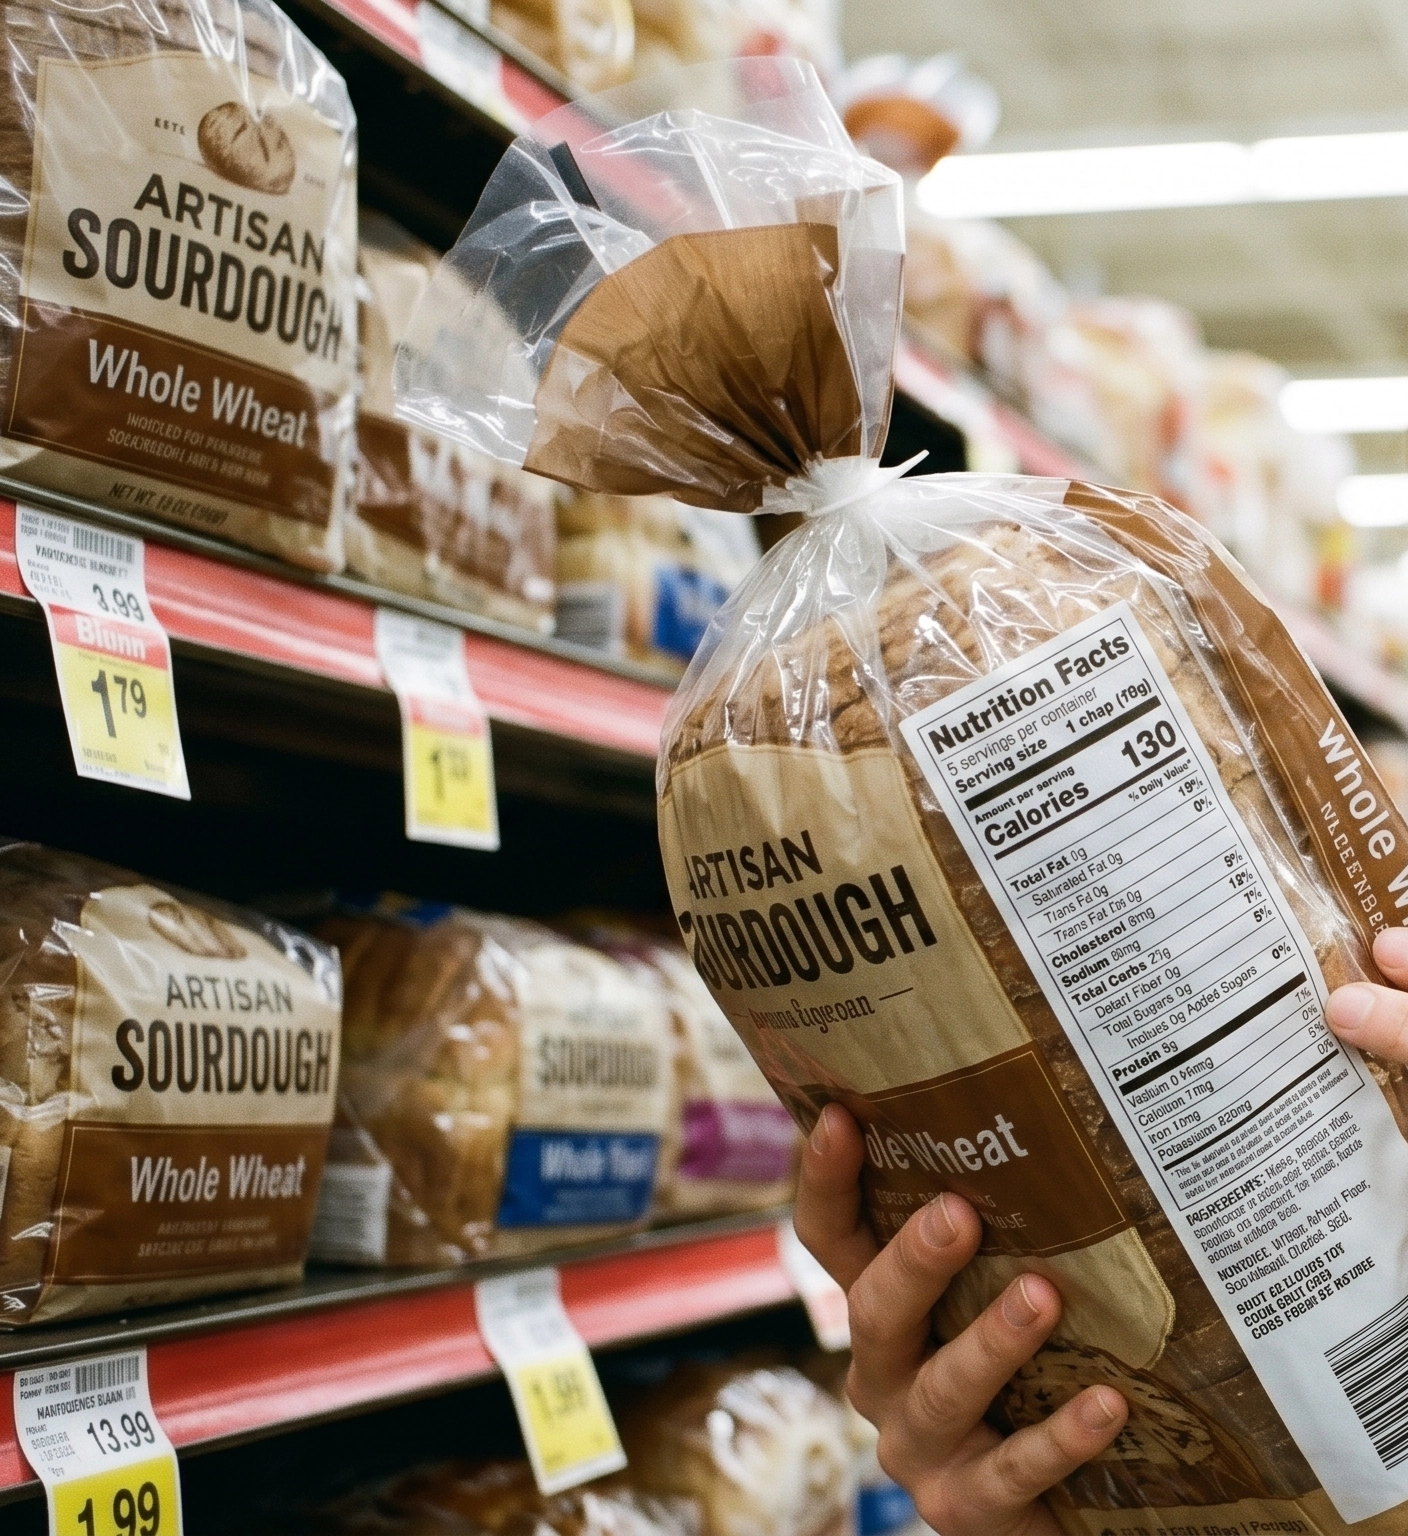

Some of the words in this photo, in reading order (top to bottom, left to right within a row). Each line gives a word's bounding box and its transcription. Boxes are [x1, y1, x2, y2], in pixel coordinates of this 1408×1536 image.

[133, 173, 325, 278] ARTISAN
[62, 207, 344, 363] SOURDOUGH
[88, 338, 202, 413] Whole
[212, 376, 310, 448] Wheat
[927, 678, 1055, 755] Nutrition
[1053, 635, 1130, 686] Facts
[946, 761, 959, 777] 5
[959, 734, 1017, 771] servings
[1016, 720, 1038, 743] per
[1040, 686, 1098, 727] container
[954, 756, 1016, 794] Serving
[1015, 738, 1048, 762] size
[1065, 720, 1077, 734] 1
[1078, 701, 1114, 727] chap
[983, 781, 1090, 847] Calories
[1120, 720, 1177, 768] 130
[974, 797, 1016, 825] Amount
[1086, 859, 1108, 877] Fat
[1106, 852, 1124, 866] 0g
[1193, 795, 1213, 813] 0%
[1009, 867, 1047, 893] Total
[1045, 855, 1071, 875] Fat
[1070, 847, 1088, 862] 0g
[1092, 884, 1110, 898] 0g
[1087, 907, 1109, 926] Fat
[1126, 889, 1143, 903] 0g
[1051, 920, 1127, 969] Cholesterol
[166, 974, 293, 1012] ARTISAN
[1070, 980, 1108, 1006] Total
[1131, 974, 1163, 999] Fiber
[1164, 965, 1182, 980] 0g
[1168, 1011, 1187, 1026] 0g
[1271, 941, 1292, 960] 0%
[1174, 983, 1193, 998] 0g
[111, 1018, 332, 1094] SOURDOUGH
[865, 1122, 911, 1170] ole
[898, 1113, 1030, 1174] Wheat
[1147, 1126, 1172, 1145] Iron
[130, 1155, 219, 1203] Whole
[228, 1152, 306, 1201] Wheat
[87, 1411, 156, 1455] 13.99
